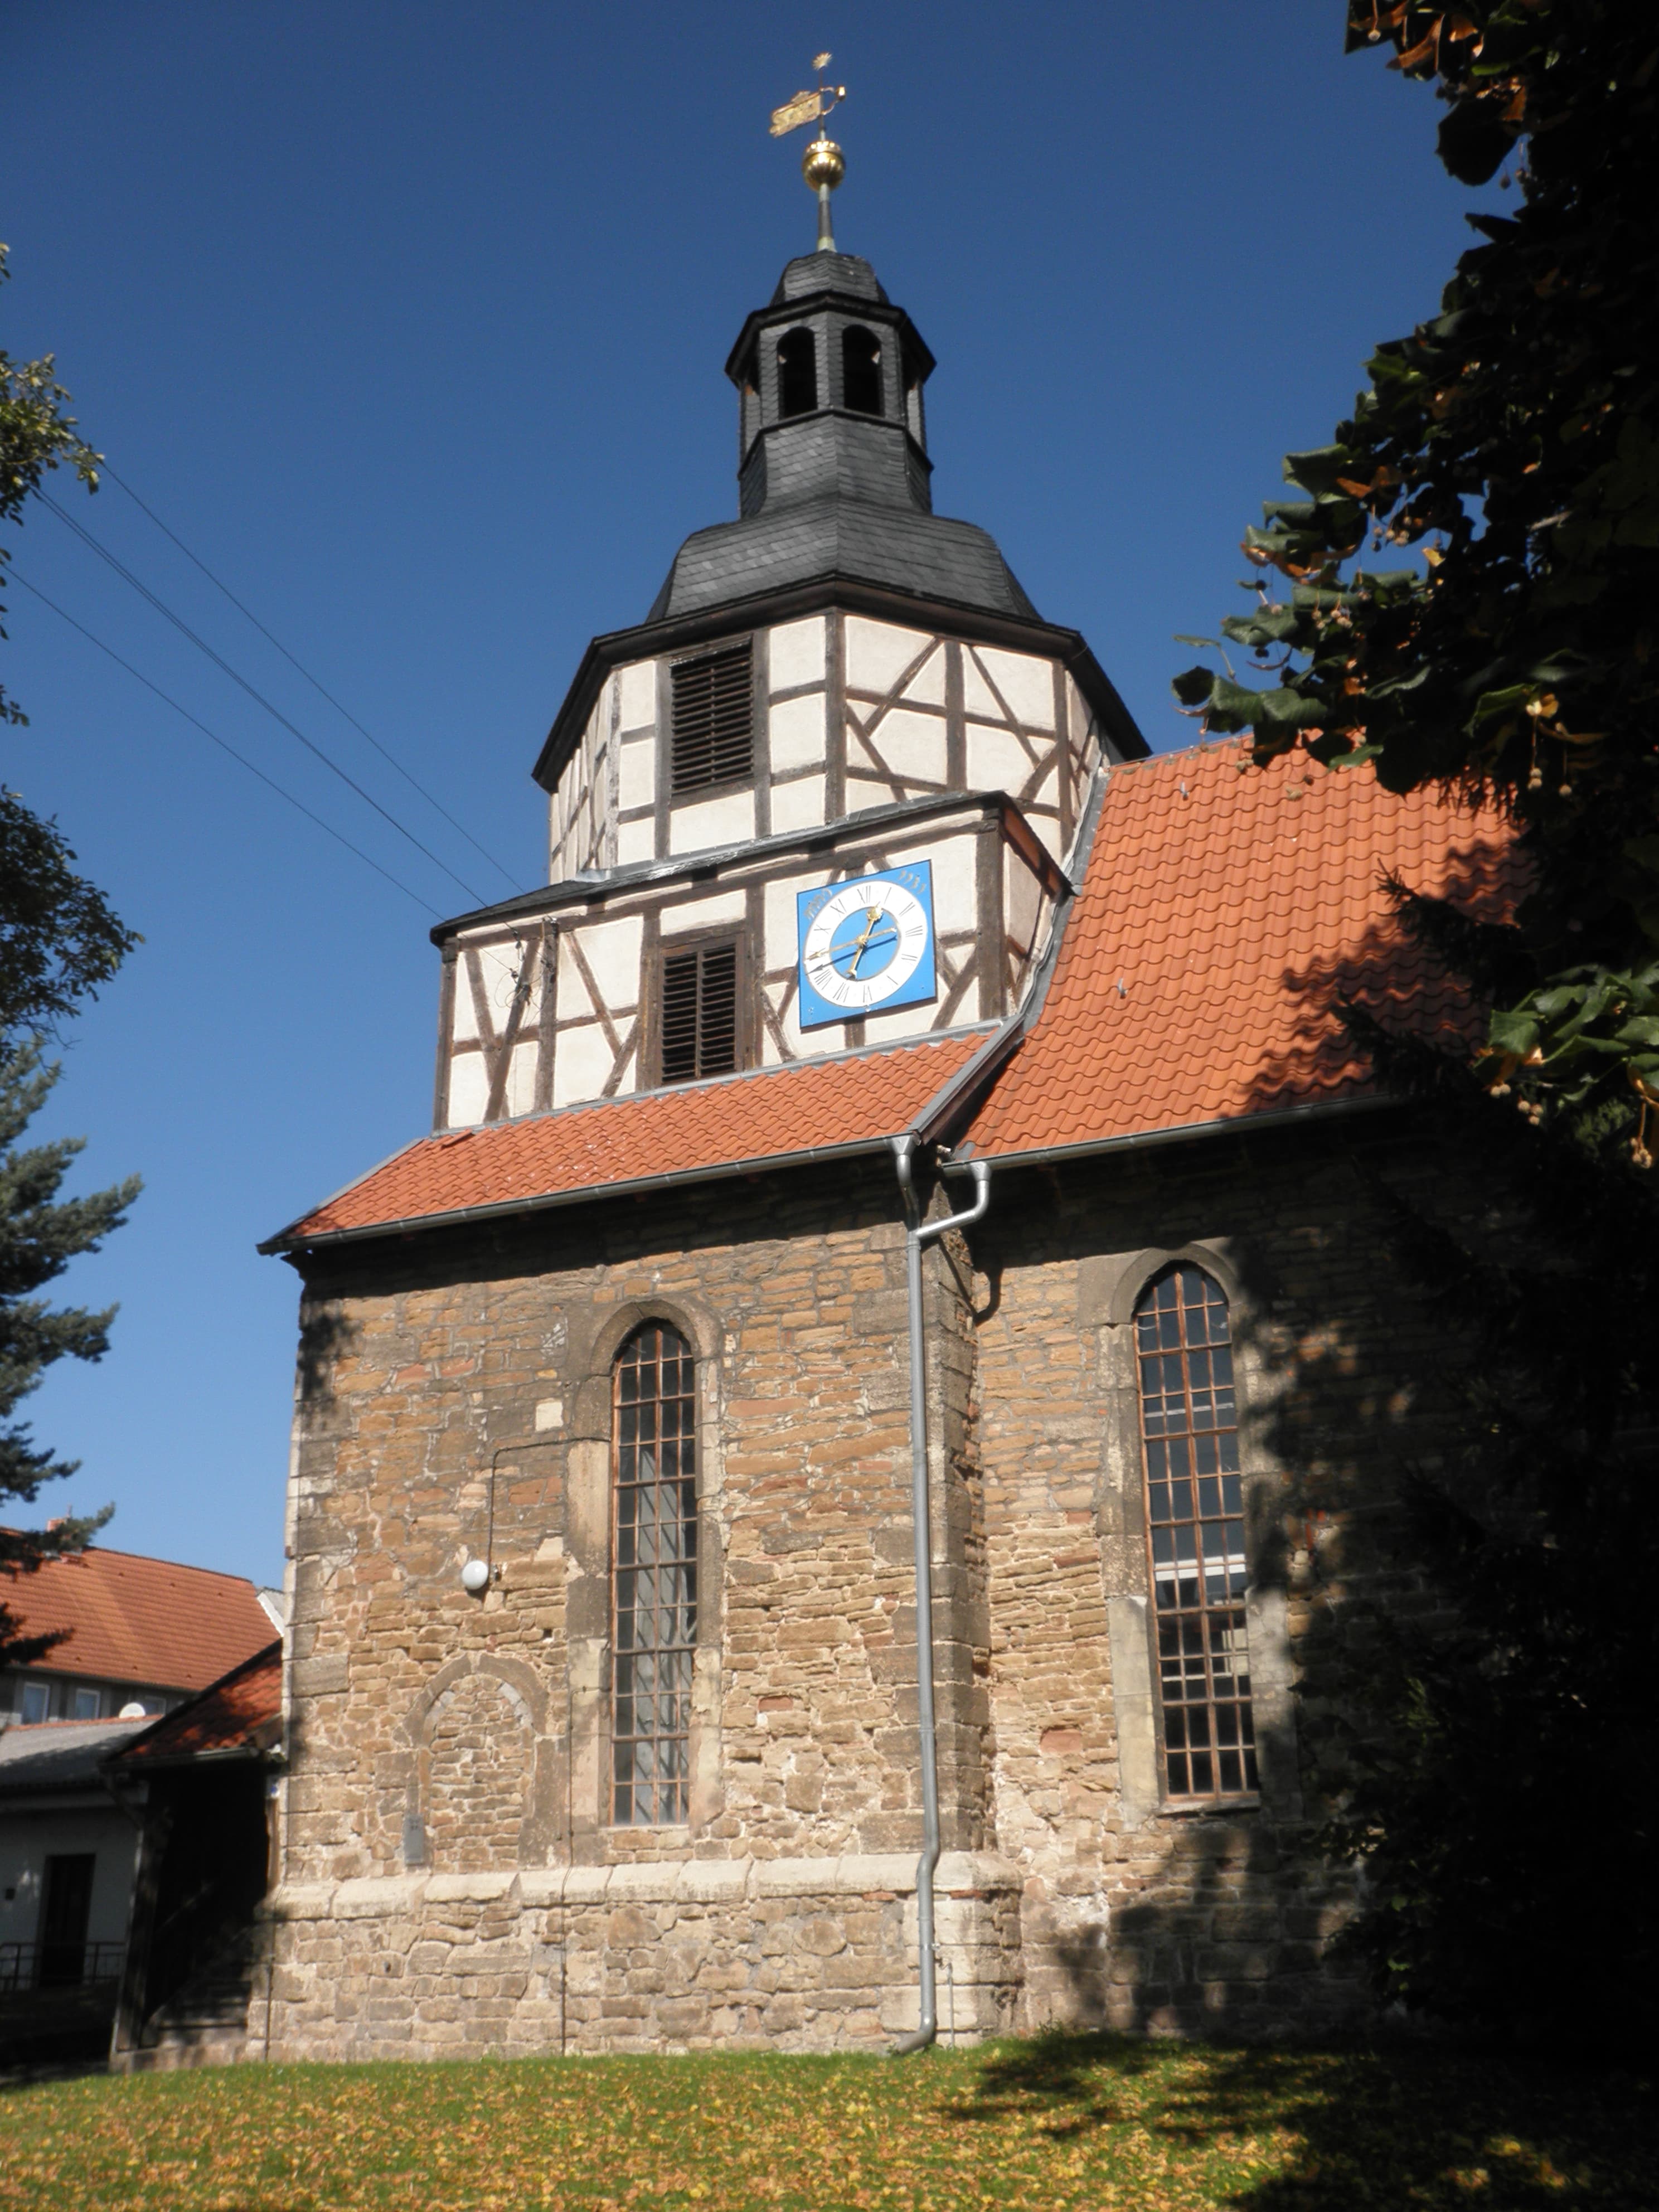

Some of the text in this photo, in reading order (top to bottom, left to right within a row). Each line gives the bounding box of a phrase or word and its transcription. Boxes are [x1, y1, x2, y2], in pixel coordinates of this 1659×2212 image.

[857, 885, 871, 905] XII
[884, 887, 892, 905] I
[830, 898, 847, 919] XI
[899, 901, 916, 917] II
[813, 924, 831, 935] X
[905, 925, 923, 938] III
[833, 982, 850, 1002] VII
